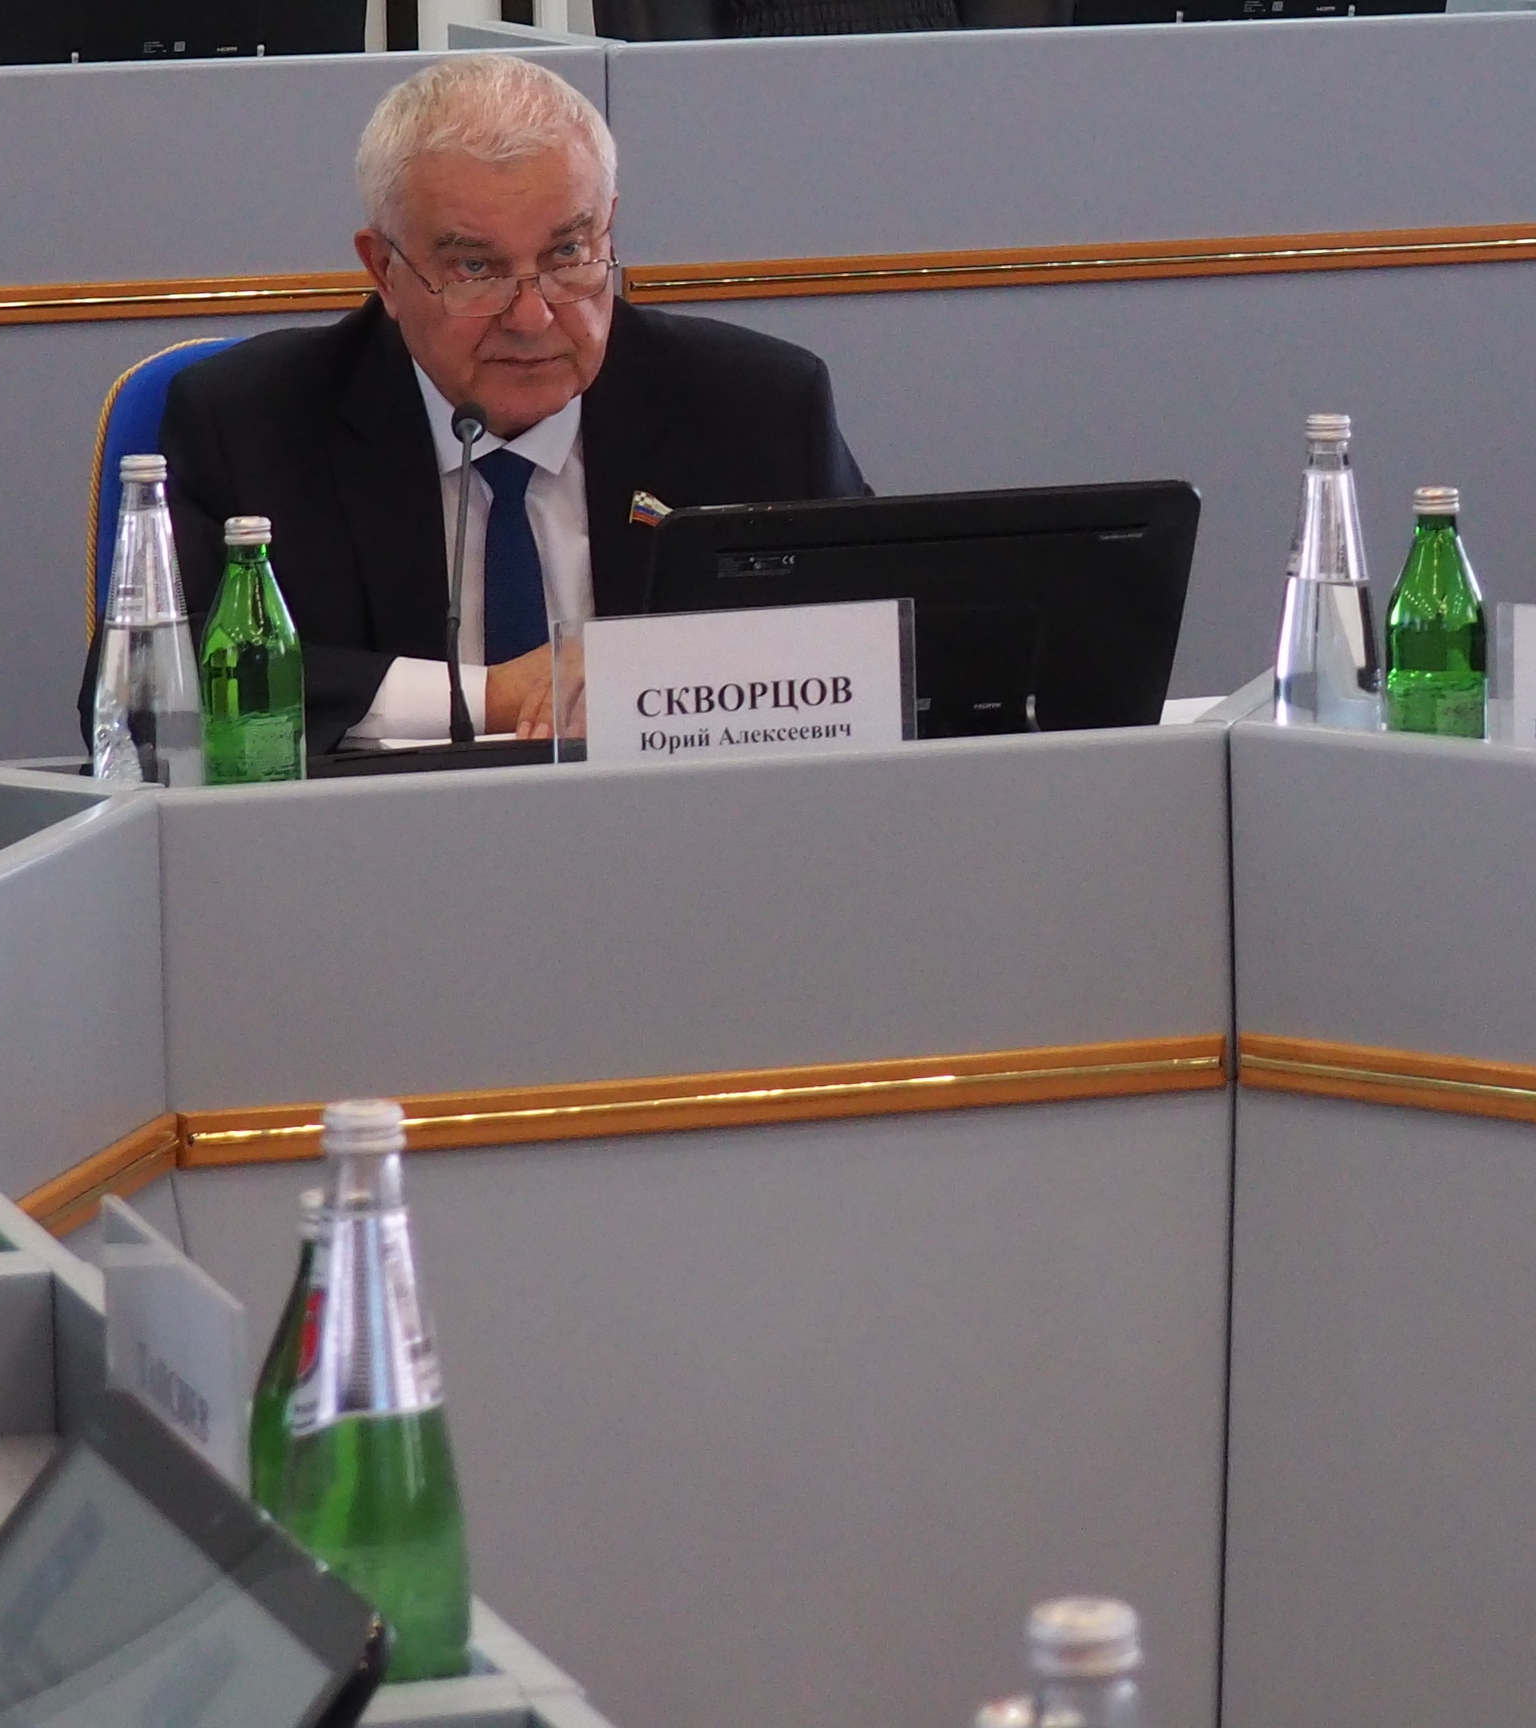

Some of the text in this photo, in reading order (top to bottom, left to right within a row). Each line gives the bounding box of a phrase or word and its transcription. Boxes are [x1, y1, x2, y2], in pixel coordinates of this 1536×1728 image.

[637, 675, 853, 717] СКВОРЦОВ
[639, 723, 852, 755] Юрий Алексеевич
